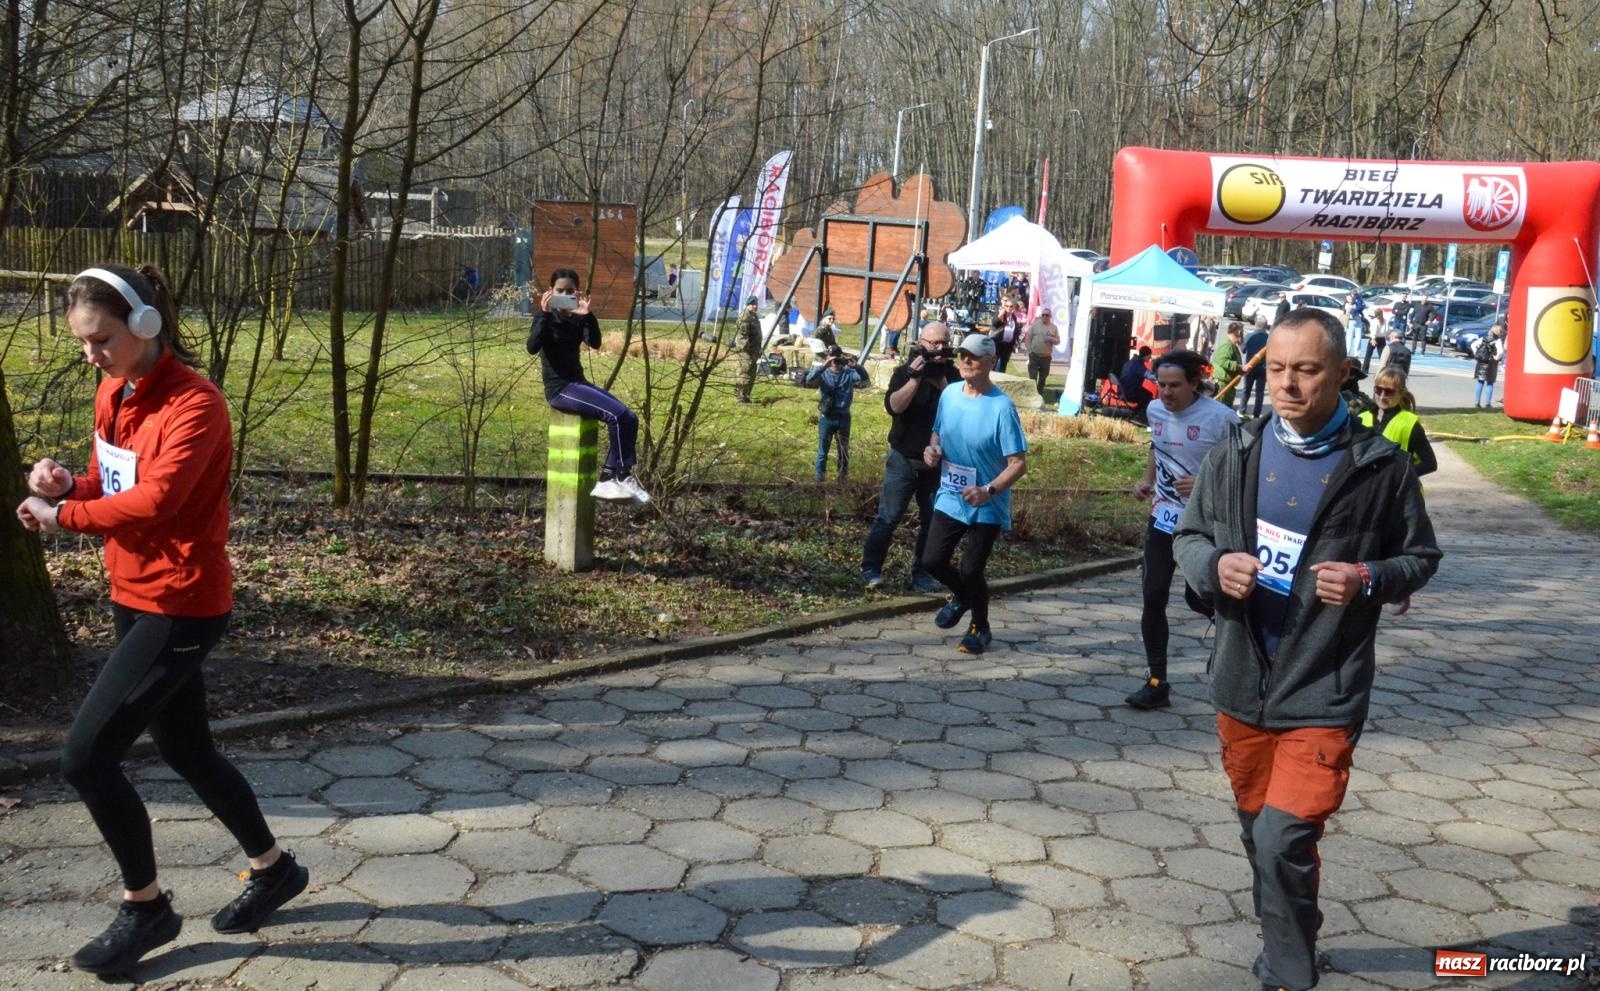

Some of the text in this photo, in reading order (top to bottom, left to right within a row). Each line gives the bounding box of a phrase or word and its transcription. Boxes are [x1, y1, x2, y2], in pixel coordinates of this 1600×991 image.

[1344, 169, 1397, 182] BIEG
[1300, 188, 1443, 209] TWARDZIELA
[948, 472, 968, 487] 128
[1256, 544, 1296, 576] 05
